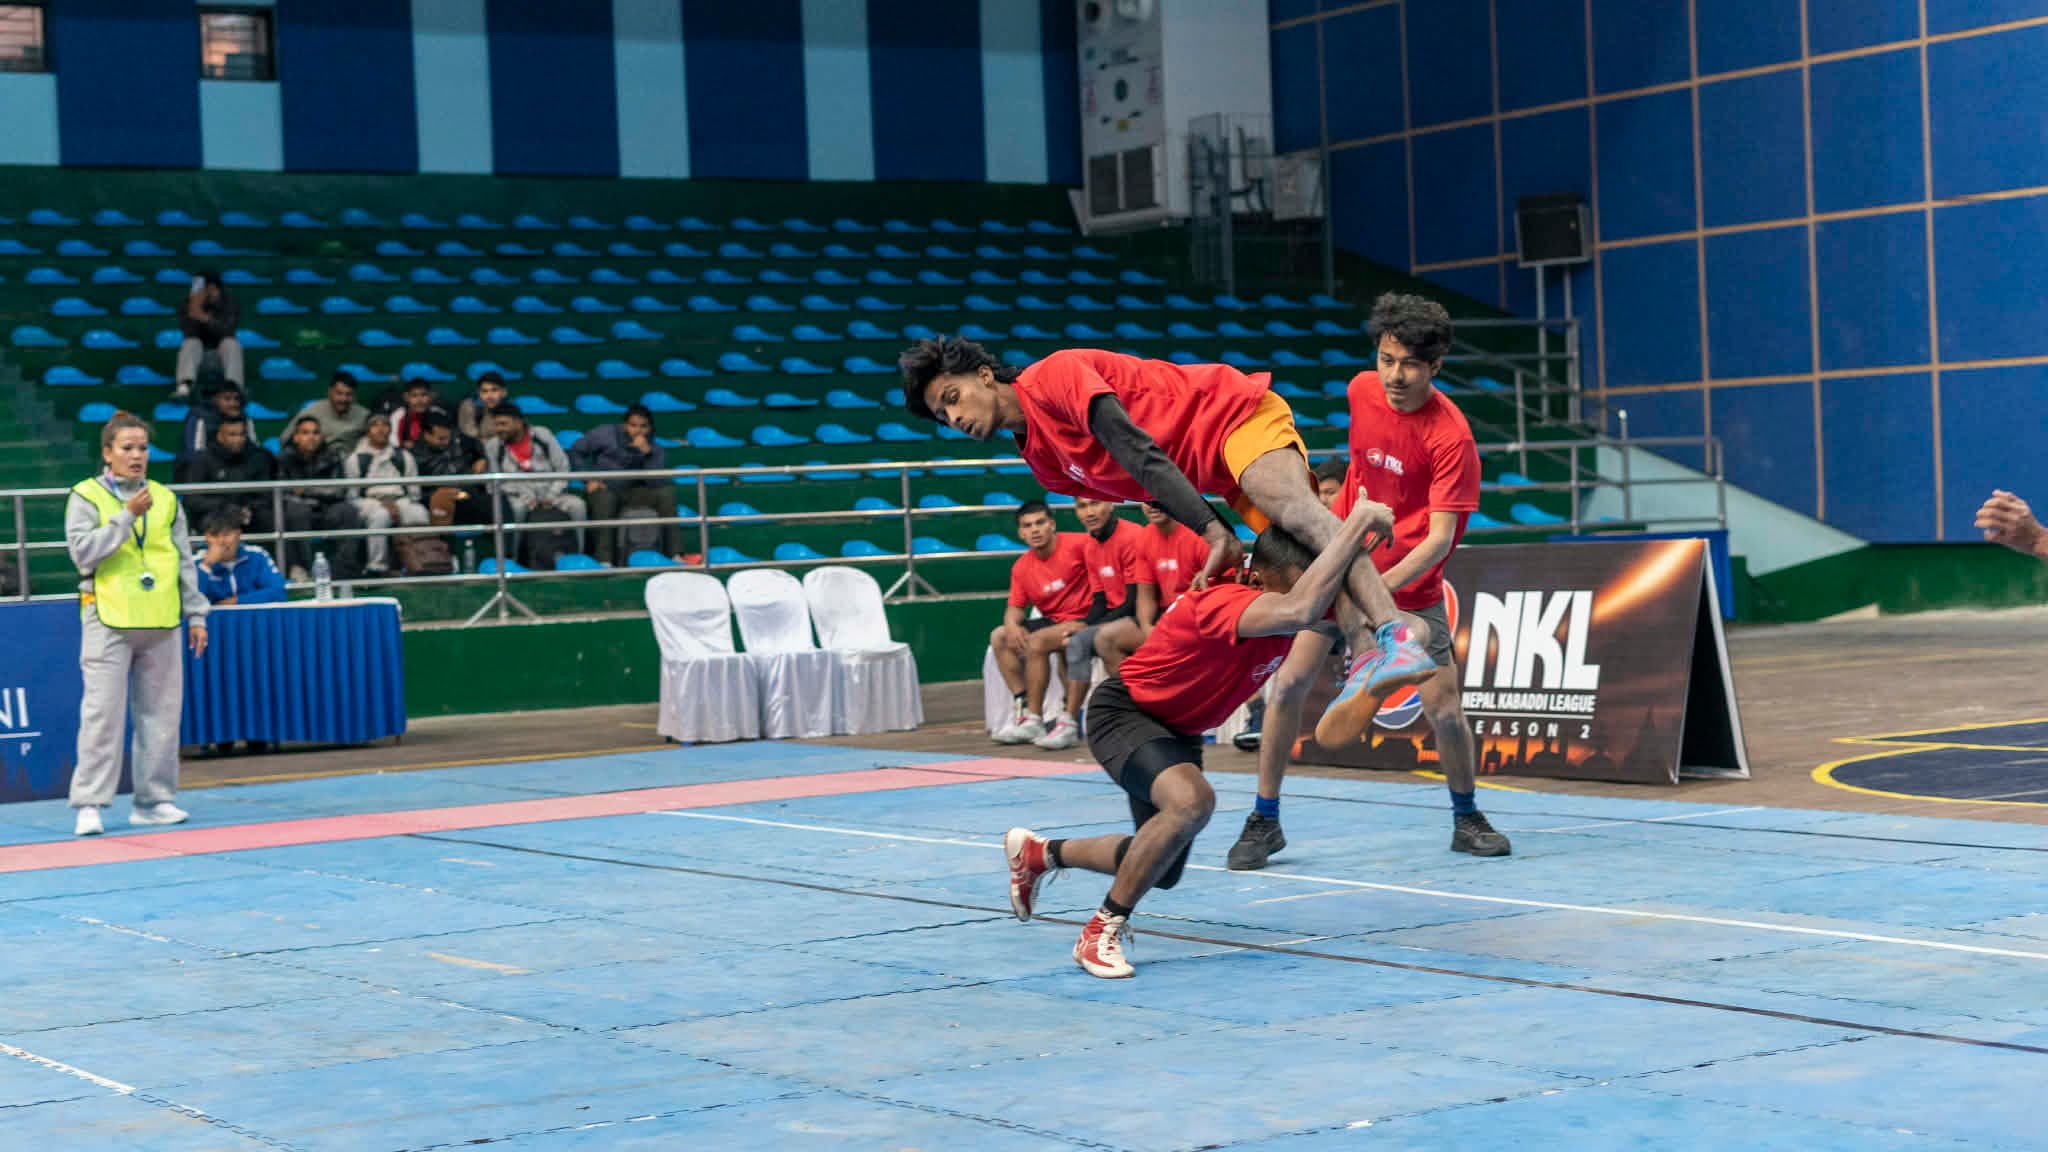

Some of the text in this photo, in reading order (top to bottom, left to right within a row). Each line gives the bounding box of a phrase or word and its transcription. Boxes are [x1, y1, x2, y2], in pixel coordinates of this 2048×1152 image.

[1464, 590, 1600, 690] NKL
[1462, 691, 1597, 712] NEPAL KABADDI LEAGUE
[1475, 719, 1591, 739] EASON 2
